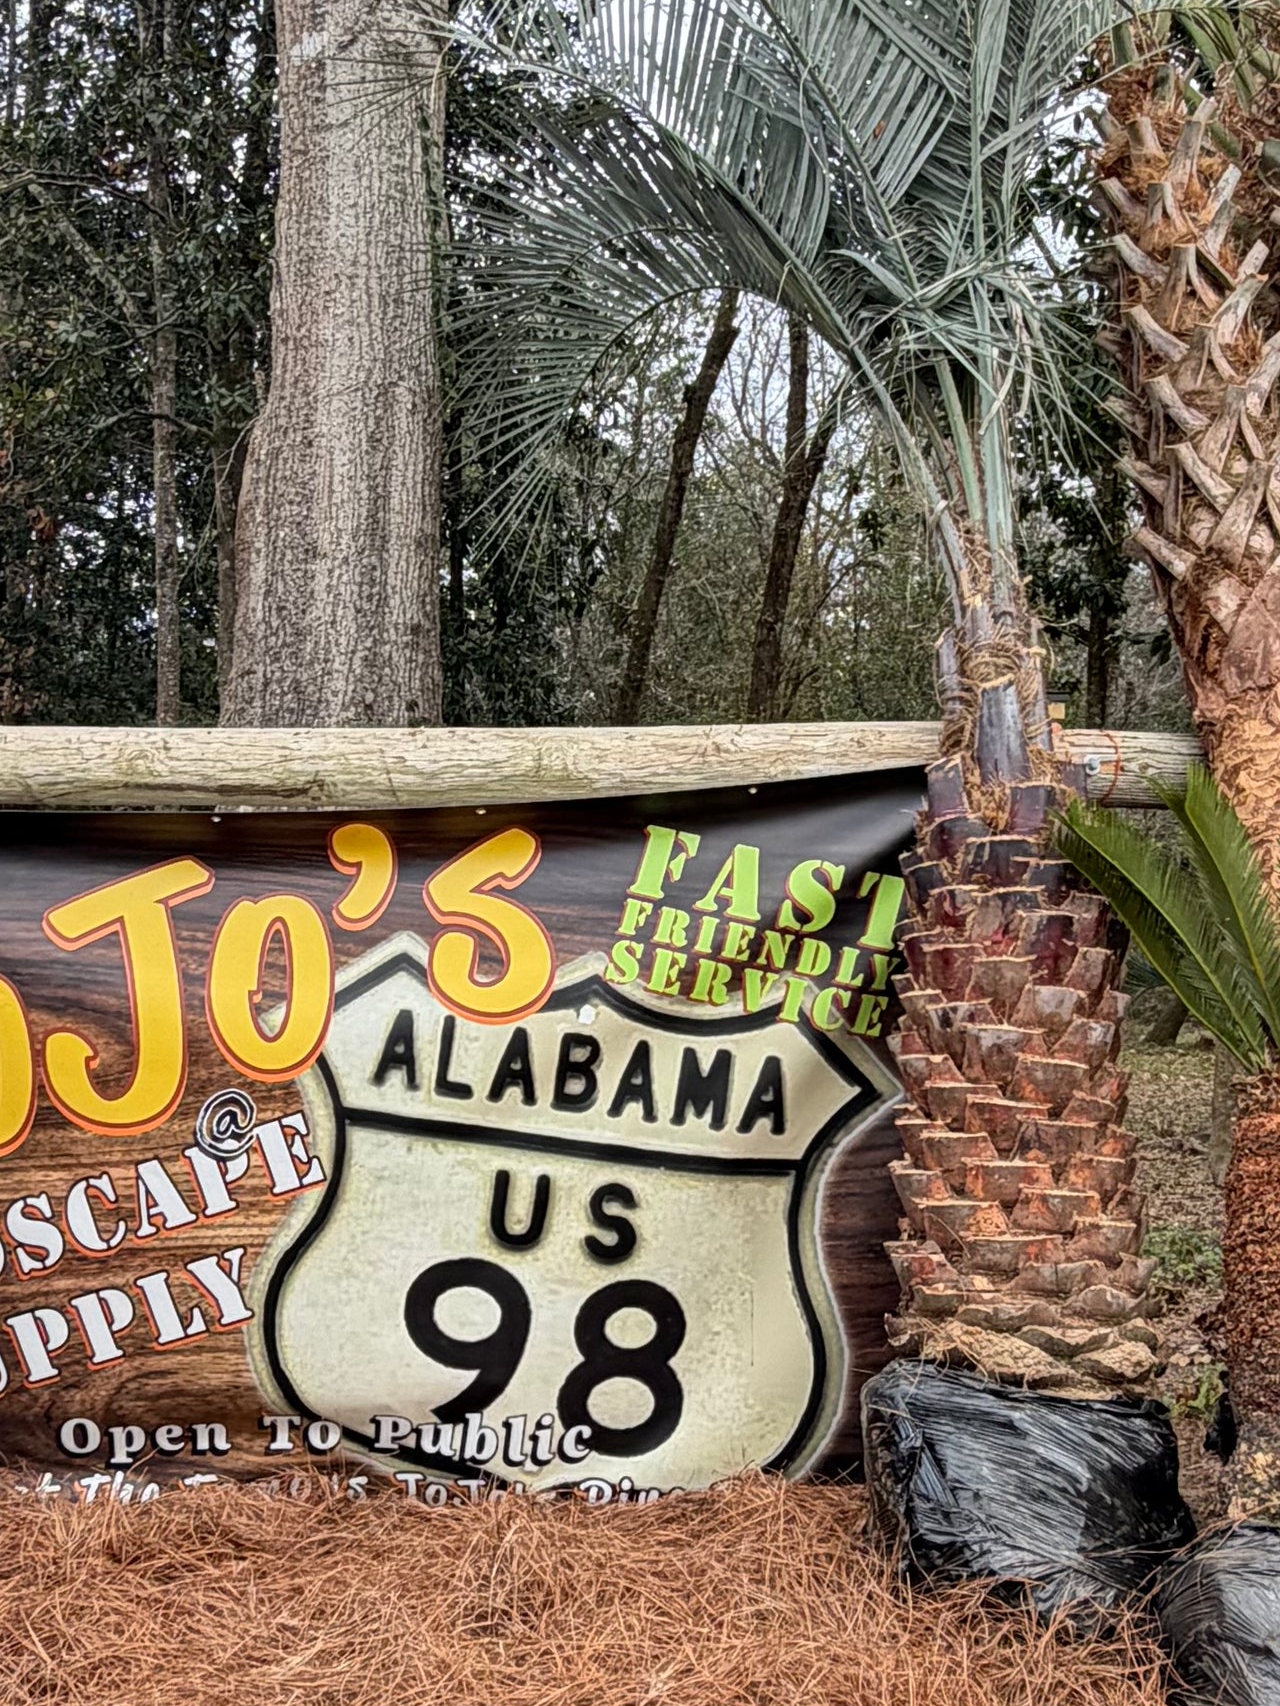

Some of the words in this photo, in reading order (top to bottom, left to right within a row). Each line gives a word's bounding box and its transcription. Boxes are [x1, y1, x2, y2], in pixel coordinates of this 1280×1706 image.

[626, 824, 906, 952] FAST
[604, 940, 889, 1038] SERVICE
[616, 898, 902, 991] FRIENDLY
[372, 1009, 787, 1136] ALABAMA
[195, 1088, 257, 1160] @
[404, 1257, 687, 1458] 98
[58, 1416, 232, 1466] Open
[262, 1413, 342, 1452] To
[372, 1412, 593, 1467] Public
